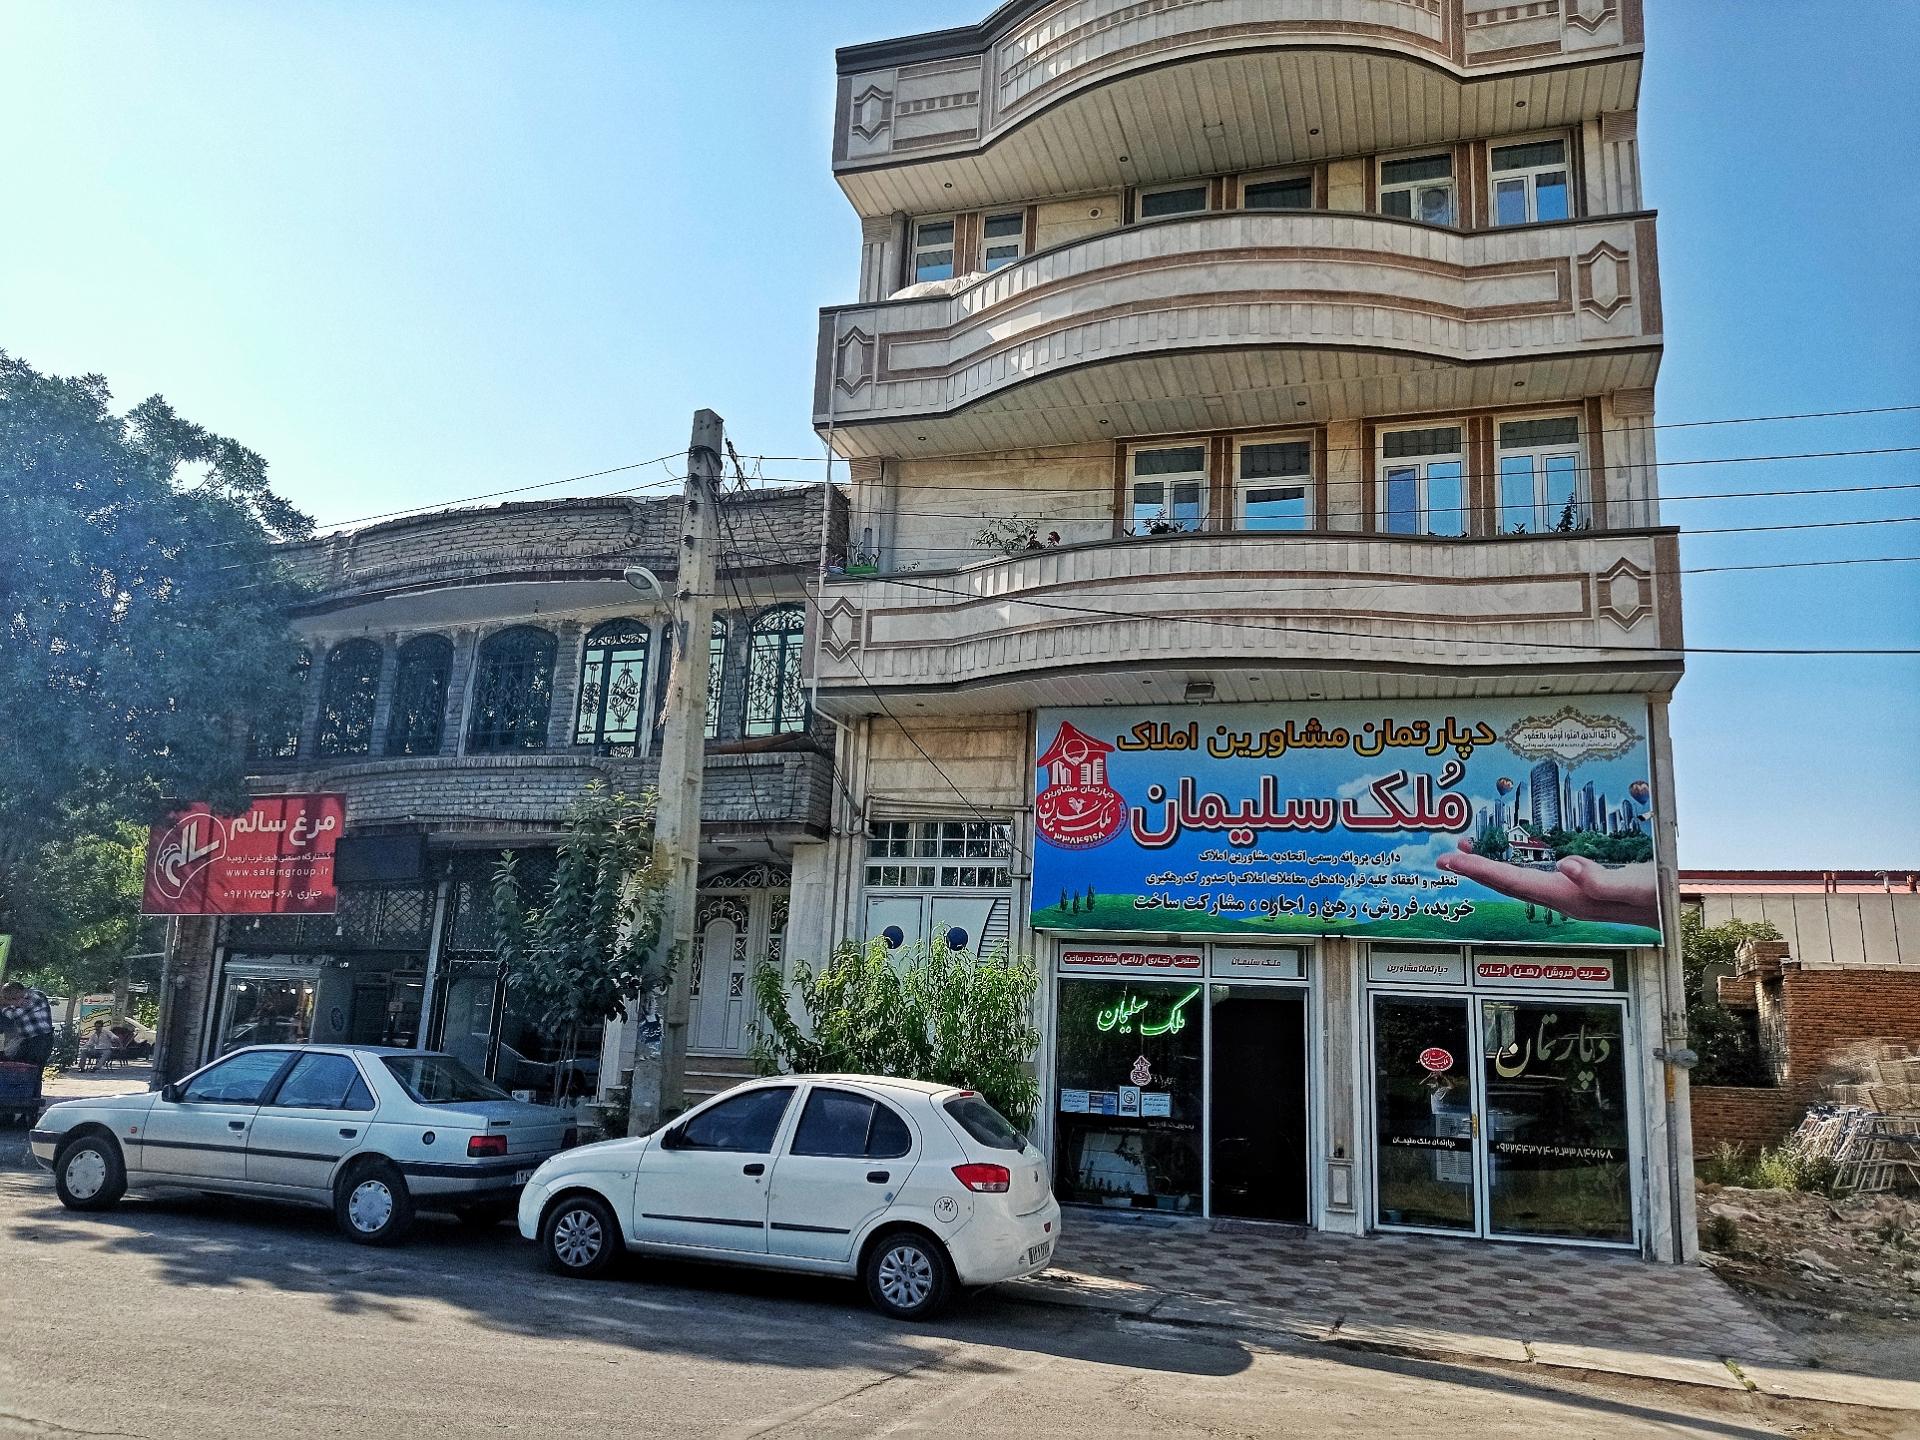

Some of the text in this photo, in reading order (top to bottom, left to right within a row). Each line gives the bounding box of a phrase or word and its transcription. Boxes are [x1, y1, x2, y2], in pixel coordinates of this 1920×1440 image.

[1117, 717, 1496, 760] دپارتمان مشاورین املاک
[1131, 774, 1337, 849] سلیمان
[230, 810, 336, 846] مرغ سالم
[302, 852, 331, 862] کشتارگاه
[1199, 850, 1401, 866] دارای پروانه رسمی اتحادیه مشاورین املاک
[226, 866, 329, 878] www.salemgroup.ir
[1146, 871, 1458, 889] تنظیم و انعقاد کلیه قراردادهای معاملات املاک با صدور کد رهگیری
[1133, 892, 1181, 911] ساخت
[1183, 893, 1245, 916] مشارکت
[1259, 894, 1304, 917] اجاره
[1308, 901, 1318, 917] و
[1321, 899, 1357, 918] رهن
[1064, 955, 1083, 963] ساخت
[1084, 956, 1091, 964] در
[1092, 954, 1118, 964] مشارکت
[1121, 954, 1143, 965] زراعی
[1148, 955, 1170, 966] تجاری
[1387, 963, 1449, 976] دپارتمان مشاورین
[1479, 965, 1607, 978] خرید فروش رهن اجاره
[1096, 987, 1200, 1036] ملک سلیمان
[1495, 1014, 1610, 1090] دپارتمان
[1432, 1137, 1456, 1149] دپارتمان
